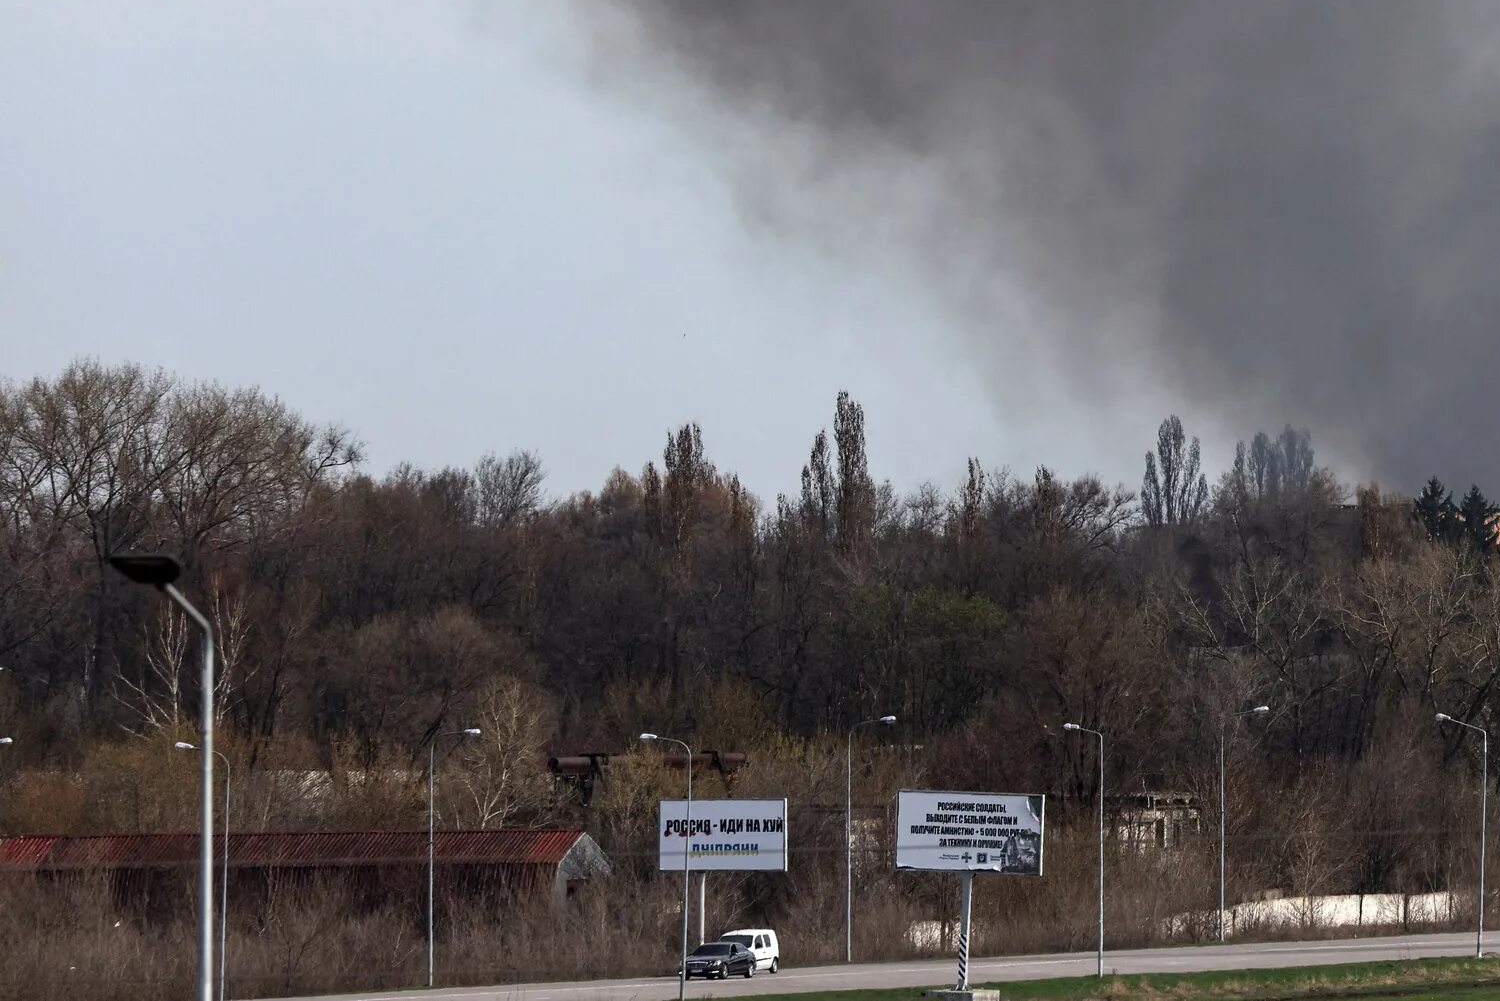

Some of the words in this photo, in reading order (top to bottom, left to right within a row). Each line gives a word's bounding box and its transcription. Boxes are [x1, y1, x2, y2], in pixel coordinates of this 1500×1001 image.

[938, 802, 975, 812] РОССИЙСКИЕ
[926, 813, 958, 824] ВЫХОДИТЕ
[959, 815, 964, 824] С
[964, 815, 987, 825] БЕЛЫМ
[987, 816, 1013, 826] ФЛАГОМ
[1013, 816, 1018, 826] И
[666, 819, 711, 833] РОССИЯ
[720, 819, 744, 834] ИДИ
[746, 819, 761, 833] НА
[762, 817, 783, 833] ХУЙ
[911, 825, 940, 835] ПОЛУЧИТЕ
[941, 826, 974, 836] АМНИСТИЮ
[980, 828, 984, 836] 5
[939, 838, 947, 847] ЗА
